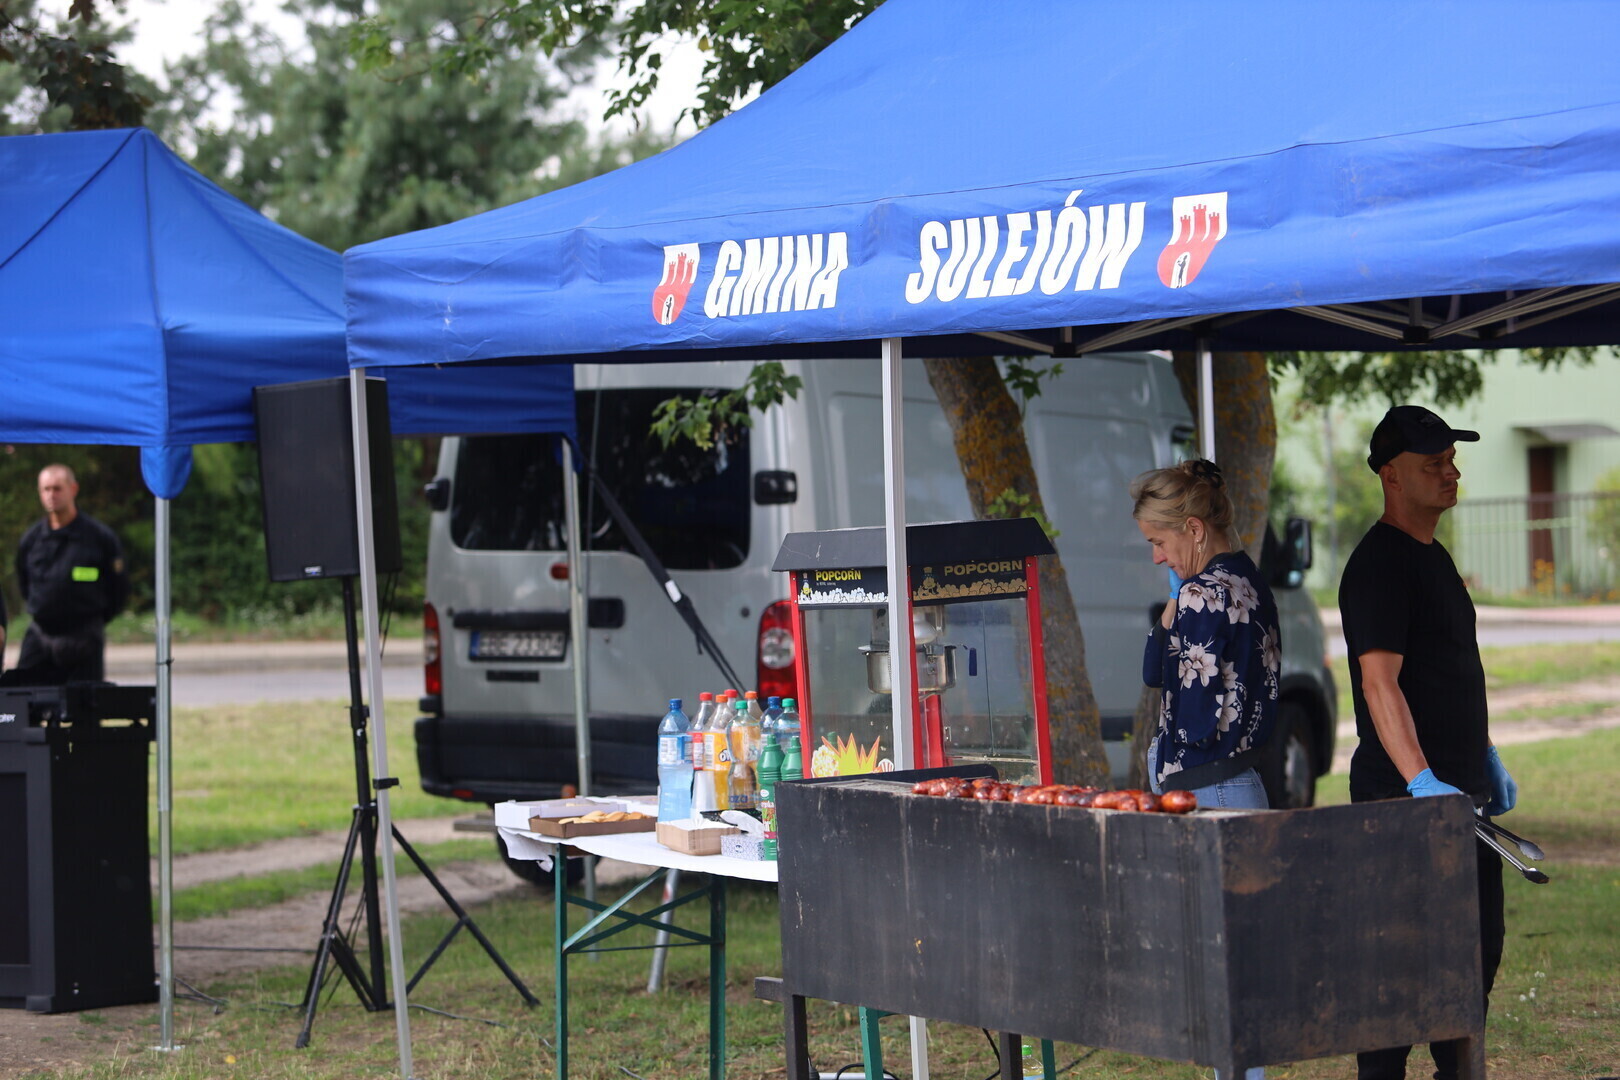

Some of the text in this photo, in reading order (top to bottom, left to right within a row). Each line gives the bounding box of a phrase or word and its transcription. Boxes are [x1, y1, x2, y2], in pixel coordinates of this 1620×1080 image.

[703, 190, 1146, 319] GMINA SULEJÓW
[815, 570, 862, 581] POPCORN
[943, 560, 1023, 576] POPCORN
